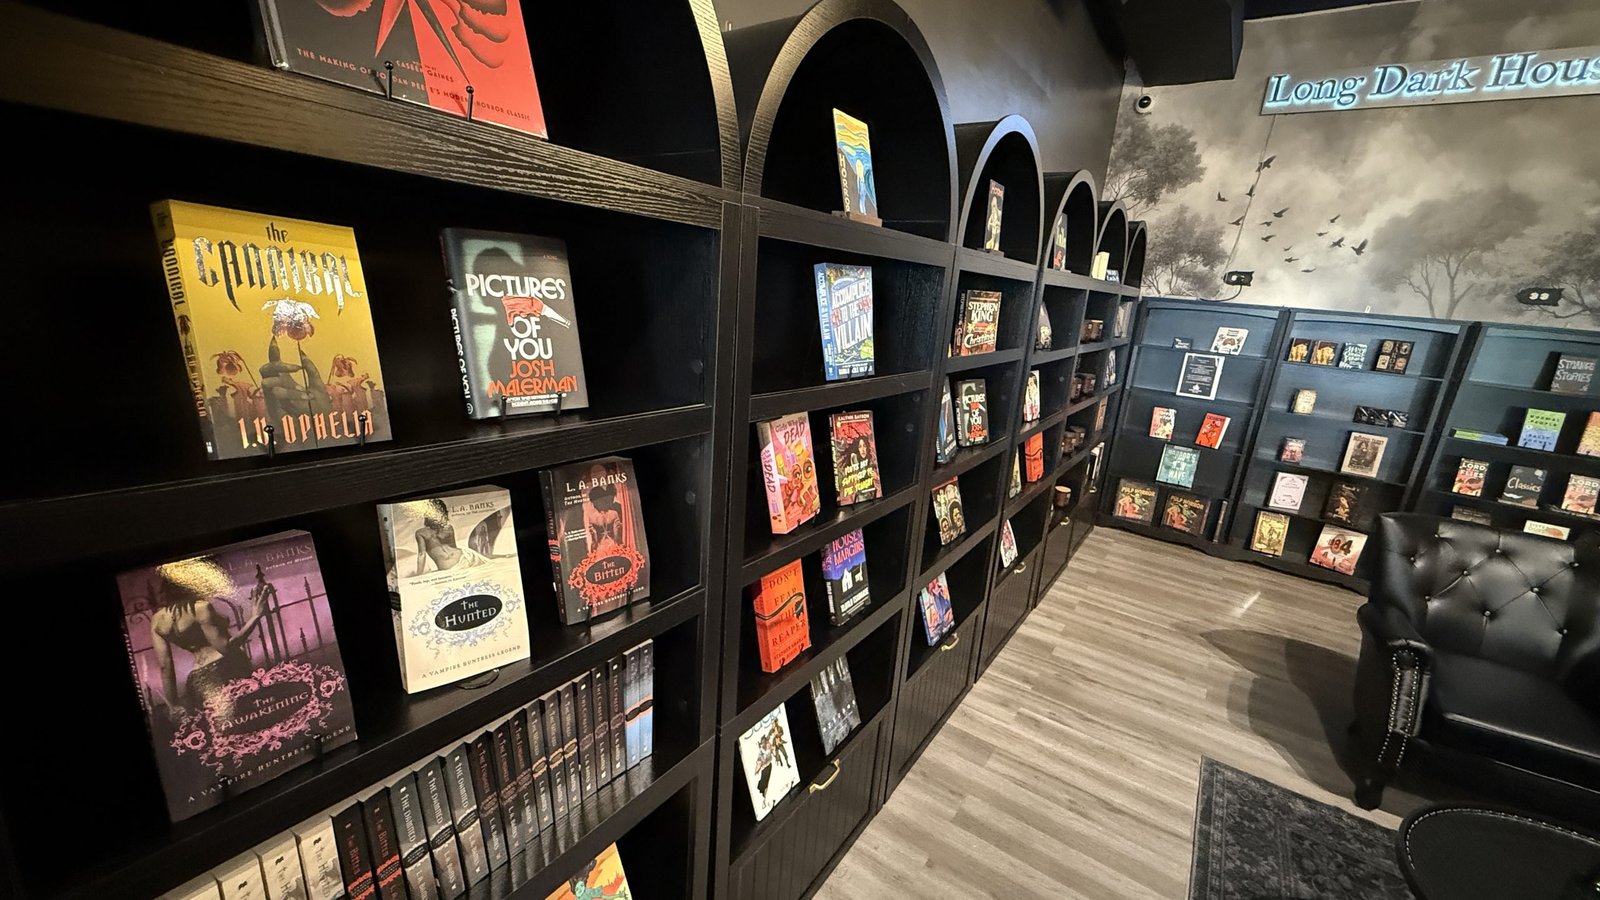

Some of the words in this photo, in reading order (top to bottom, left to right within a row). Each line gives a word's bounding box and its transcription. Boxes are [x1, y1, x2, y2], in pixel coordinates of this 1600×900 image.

[297, 48, 316, 60] THE
[319, 54, 356, 71] MAKING
[376, 71, 408, 86] JODAN
[411, 81, 441, 96] PEEE'S
[443, 91, 471, 104] MODER
[476, 101, 504, 114] HORROR
[506, 108, 530, 121] CLASSIC
[427, 69, 454, 83] GAINES
[1264, 73, 1365, 108] Long
[1367, 59, 1480, 99] Dark
[838, 153, 851, 213] HORROR
[265, 222, 289, 244] the
[192, 235, 363, 317] CANNIBAL
[465, 273, 567, 300] PICTURES
[967, 301, 998, 312] STEPHEN
[971, 310, 994, 322] KING
[511, 316, 541, 338] OF
[504, 338, 553, 361] YOU
[510, 359, 554, 379] JOSH
[1557, 358, 1596, 371] STRANGE
[1555, 369, 1593, 383] STORIES
[487, 375, 578, 399] MALERMAN
[281, 409, 375, 445] OPHELIA
[969, 416, 982, 426] YOU
[784, 421, 805, 444] DEAD
[1462, 461, 1486, 471] LORD
[565, 481, 576, 493] L.
[578, 479, 589, 491] A.
[591, 472, 628, 488] BANKS
[763, 462, 776, 494] DEAD
[1506, 477, 1542, 493] Classics
[1571, 478, 1599, 488] LORD
[1121, 486, 1135, 494] PULP
[469, 501, 495, 512] BANKS
[832, 529, 858, 553] HOUSE
[265, 544, 312, 562] BANKS
[833, 540, 865, 567] MARGINS
[593, 566, 625, 582] BITTEN
[601, 560, 616, 570] THE
[769, 566, 799, 590] DON'T
[461, 600, 480, 611] THE
[773, 587, 798, 607] FEAR
[444, 607, 497, 628] HUNTED
[771, 620, 806, 647] REAPER
[429, 663, 461, 676] VAMPIRE
[462, 653, 496, 667] HUNTRESS
[496, 645, 521, 656] LEGEND
[221, 691, 310, 731] AWAKENING
[253, 696, 274, 708] THE
[257, 744, 311, 772] HUNTRESS
[319, 725, 351, 743] EGEND
[427, 777, 437, 794] THE
[400, 793, 410, 810] THE
[402, 809, 416, 842] DAMNED
